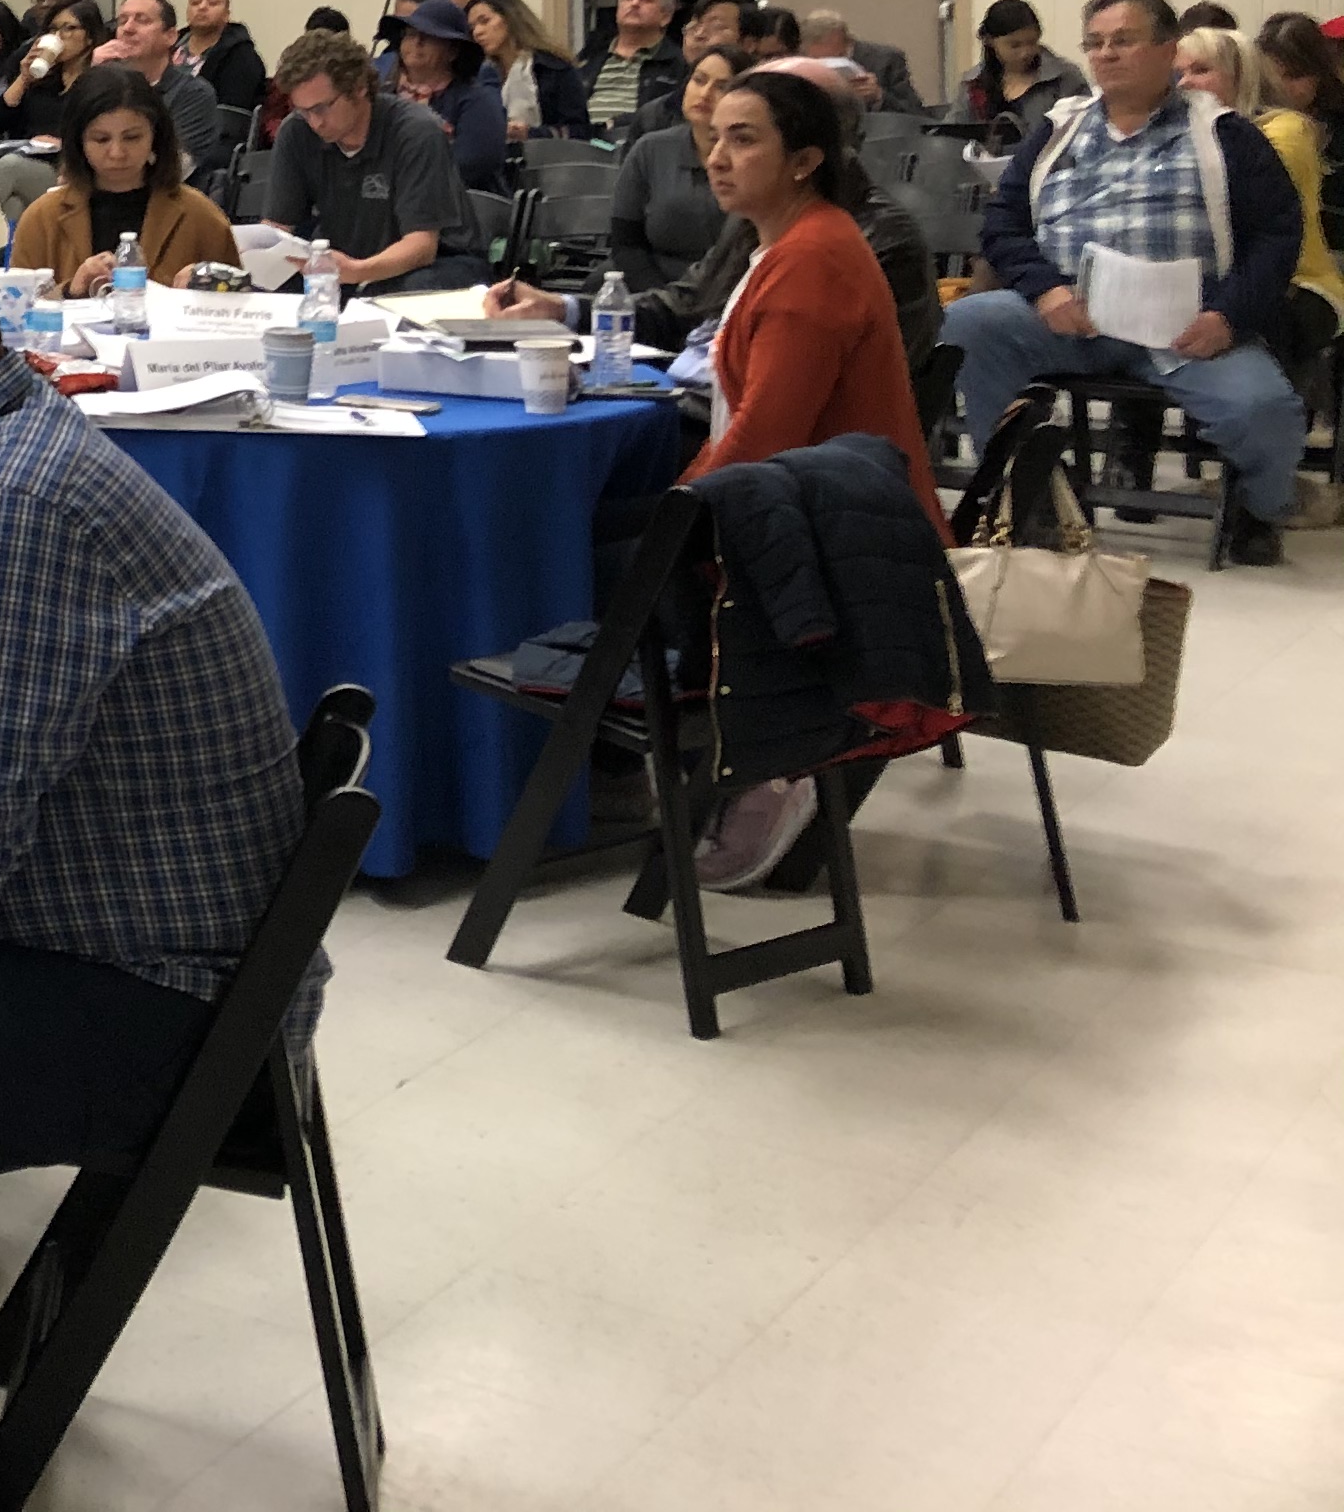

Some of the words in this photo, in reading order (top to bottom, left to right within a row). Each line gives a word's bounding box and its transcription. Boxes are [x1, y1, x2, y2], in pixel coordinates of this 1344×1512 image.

[233, 307, 273, 321] Farris
[147, 362, 179, 374] Maria
[182, 362, 200, 373] del
